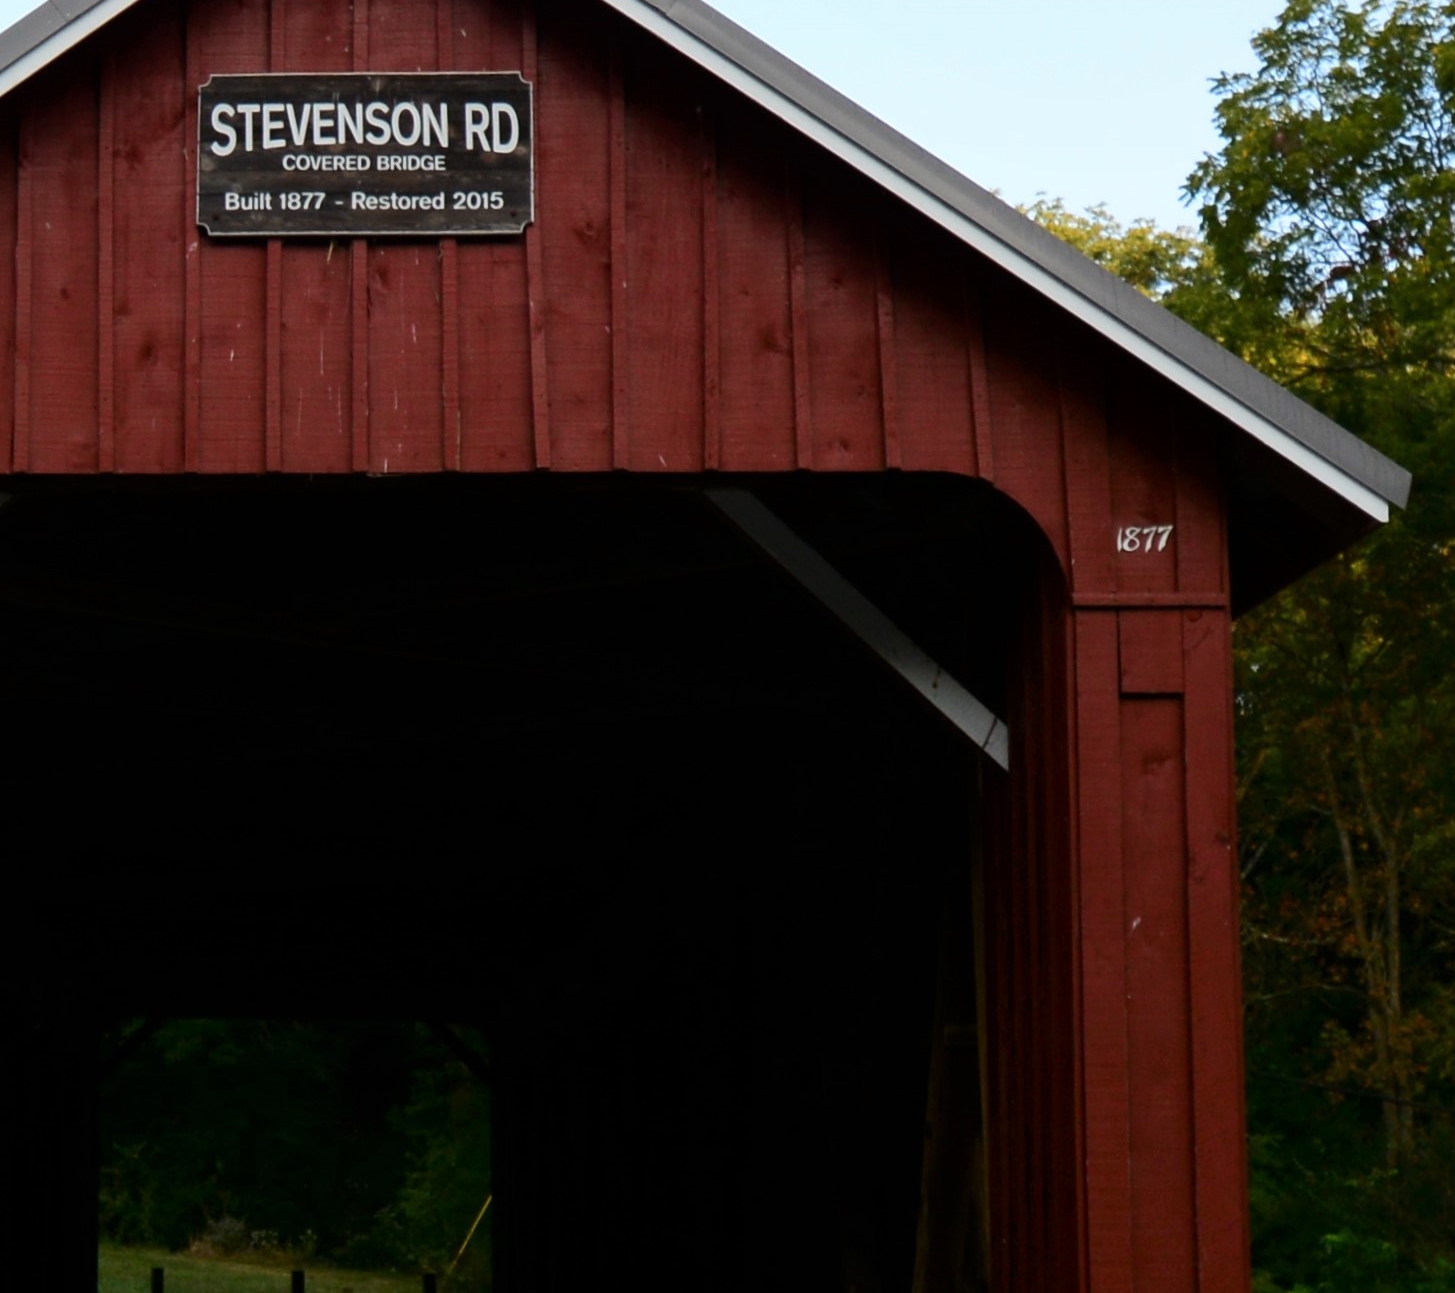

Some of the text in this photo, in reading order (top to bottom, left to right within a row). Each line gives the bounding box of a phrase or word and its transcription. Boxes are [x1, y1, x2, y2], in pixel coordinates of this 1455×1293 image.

[209, 102, 519, 156] STEVENSON RD
[282, 155, 446, 171] COVERED BRIDGE
[224, 193, 272, 210] Built
[279, 193, 325, 210] 1877
[351, 192, 445, 210] Restored
[452, 192, 504, 210] 2015
[1117, 525, 1174, 553] 1877
